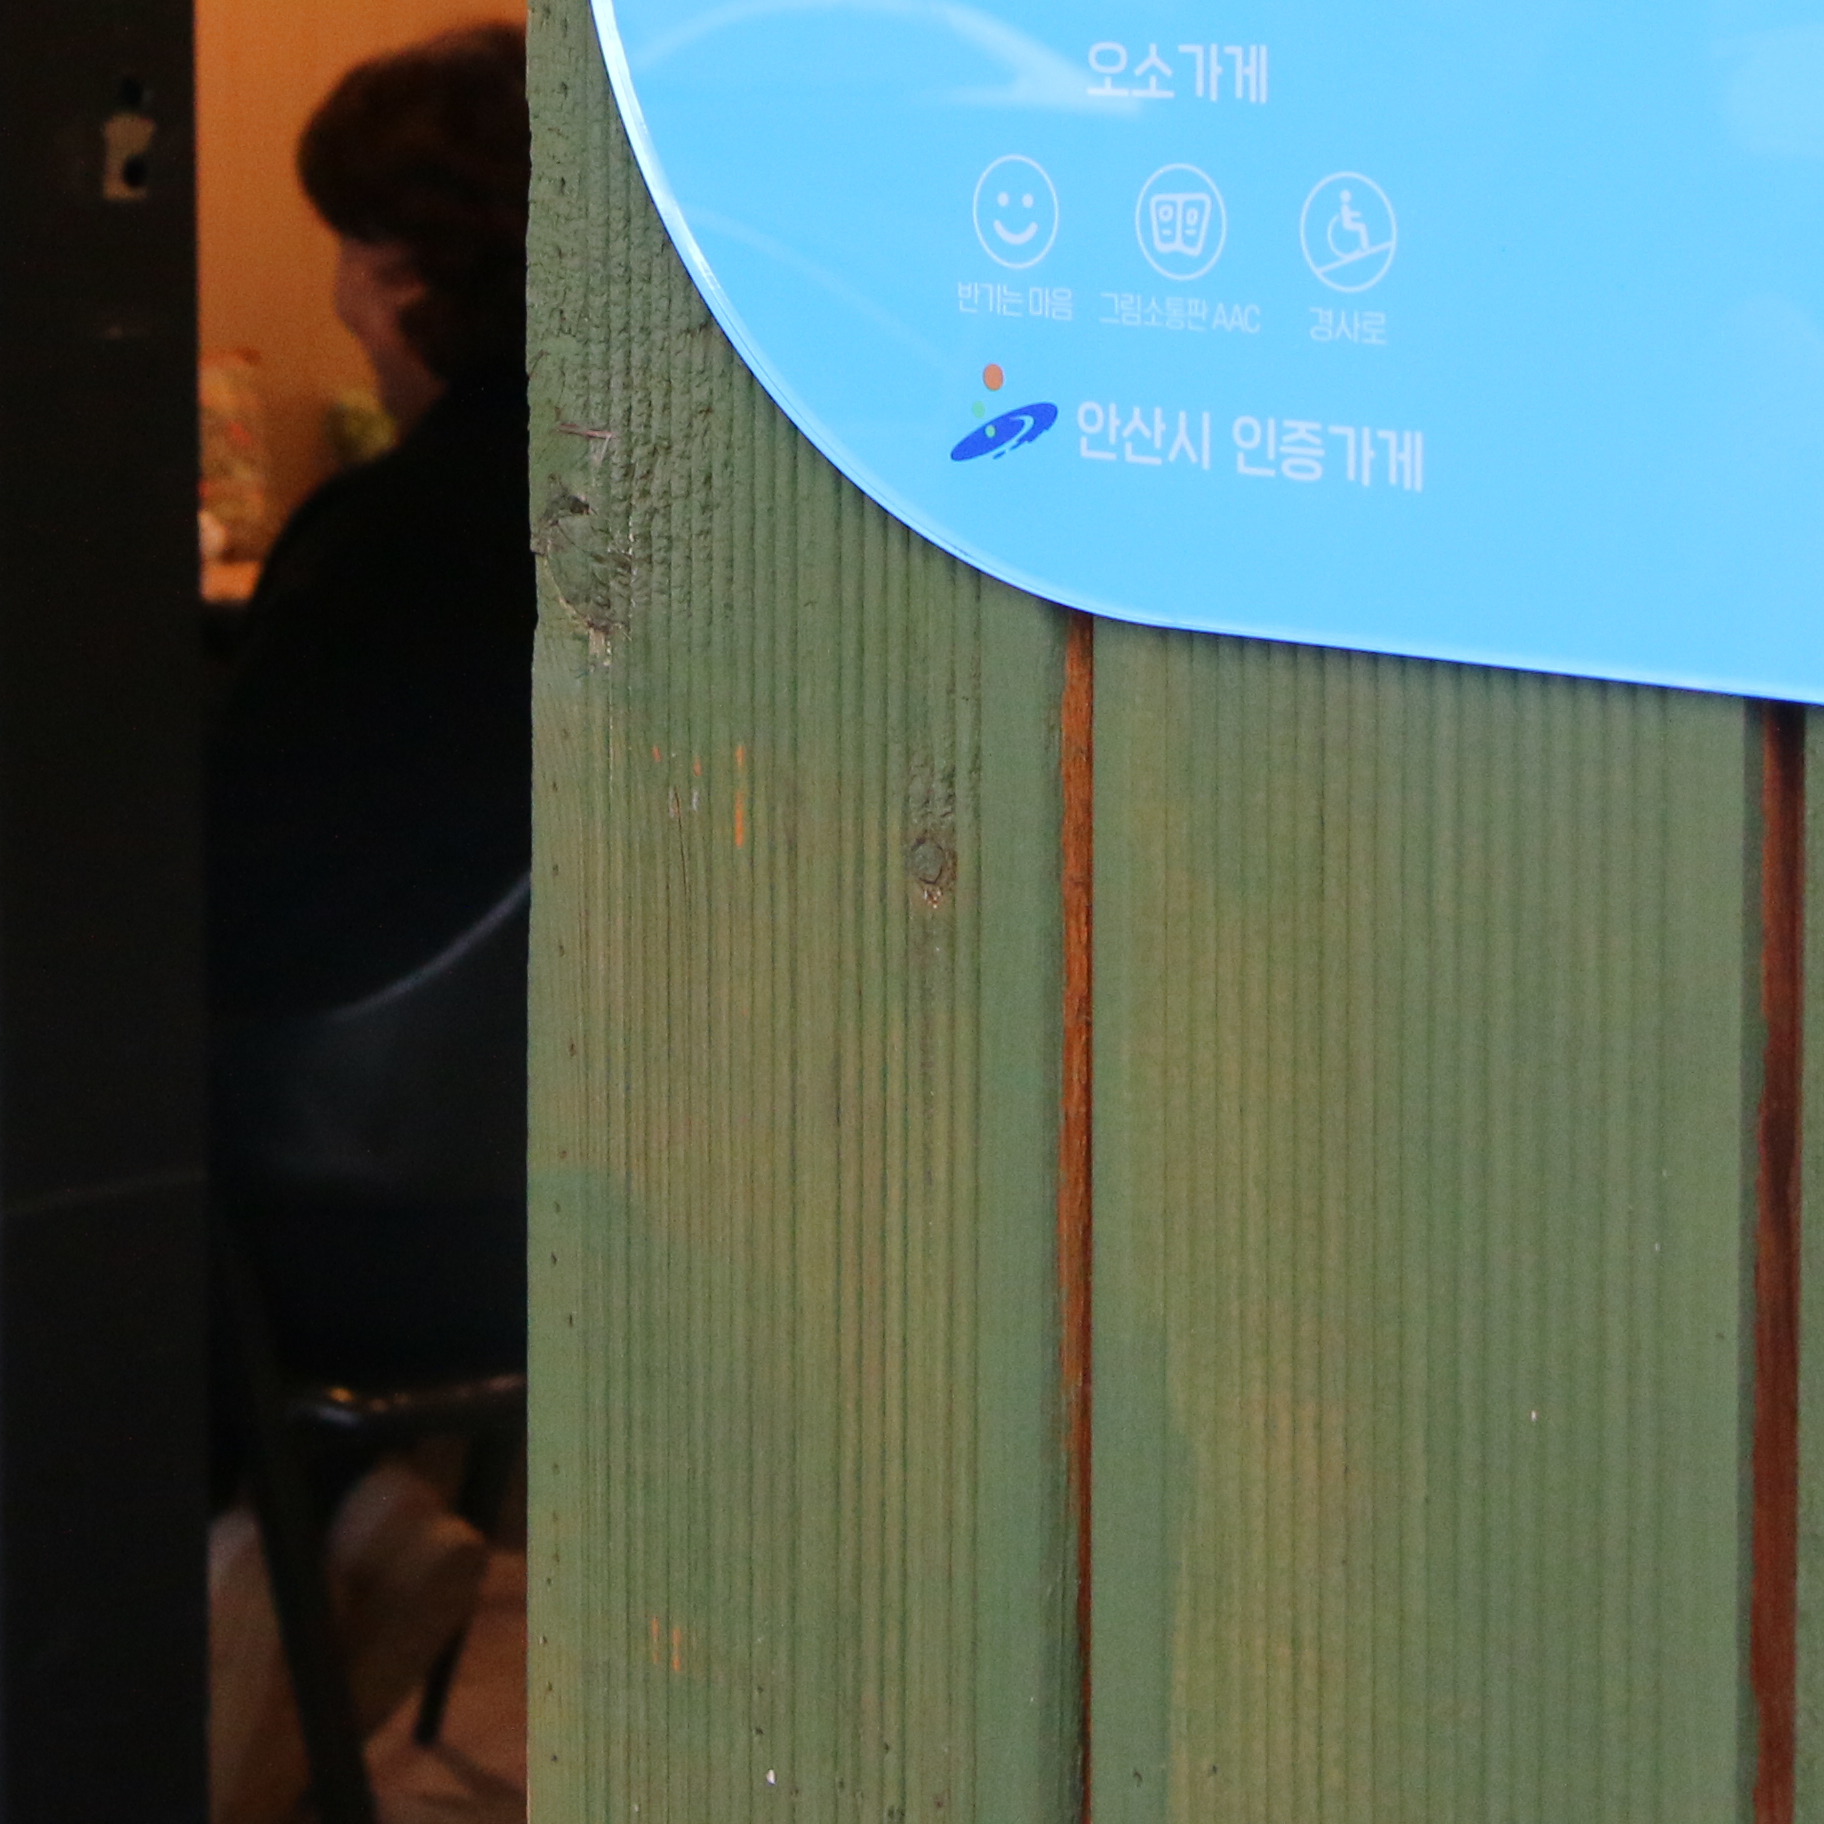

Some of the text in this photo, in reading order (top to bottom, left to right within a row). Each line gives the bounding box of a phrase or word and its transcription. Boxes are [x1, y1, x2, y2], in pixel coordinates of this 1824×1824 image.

[1085, 40, 1268, 104] 오소가게
[957, 281, 1073, 322] 반기는 마음
[1212, 304, 1261, 334] AAC
[1309, 307, 1387, 345] 경사로
[1076, 400, 1424, 493] 안산시 인증가게
